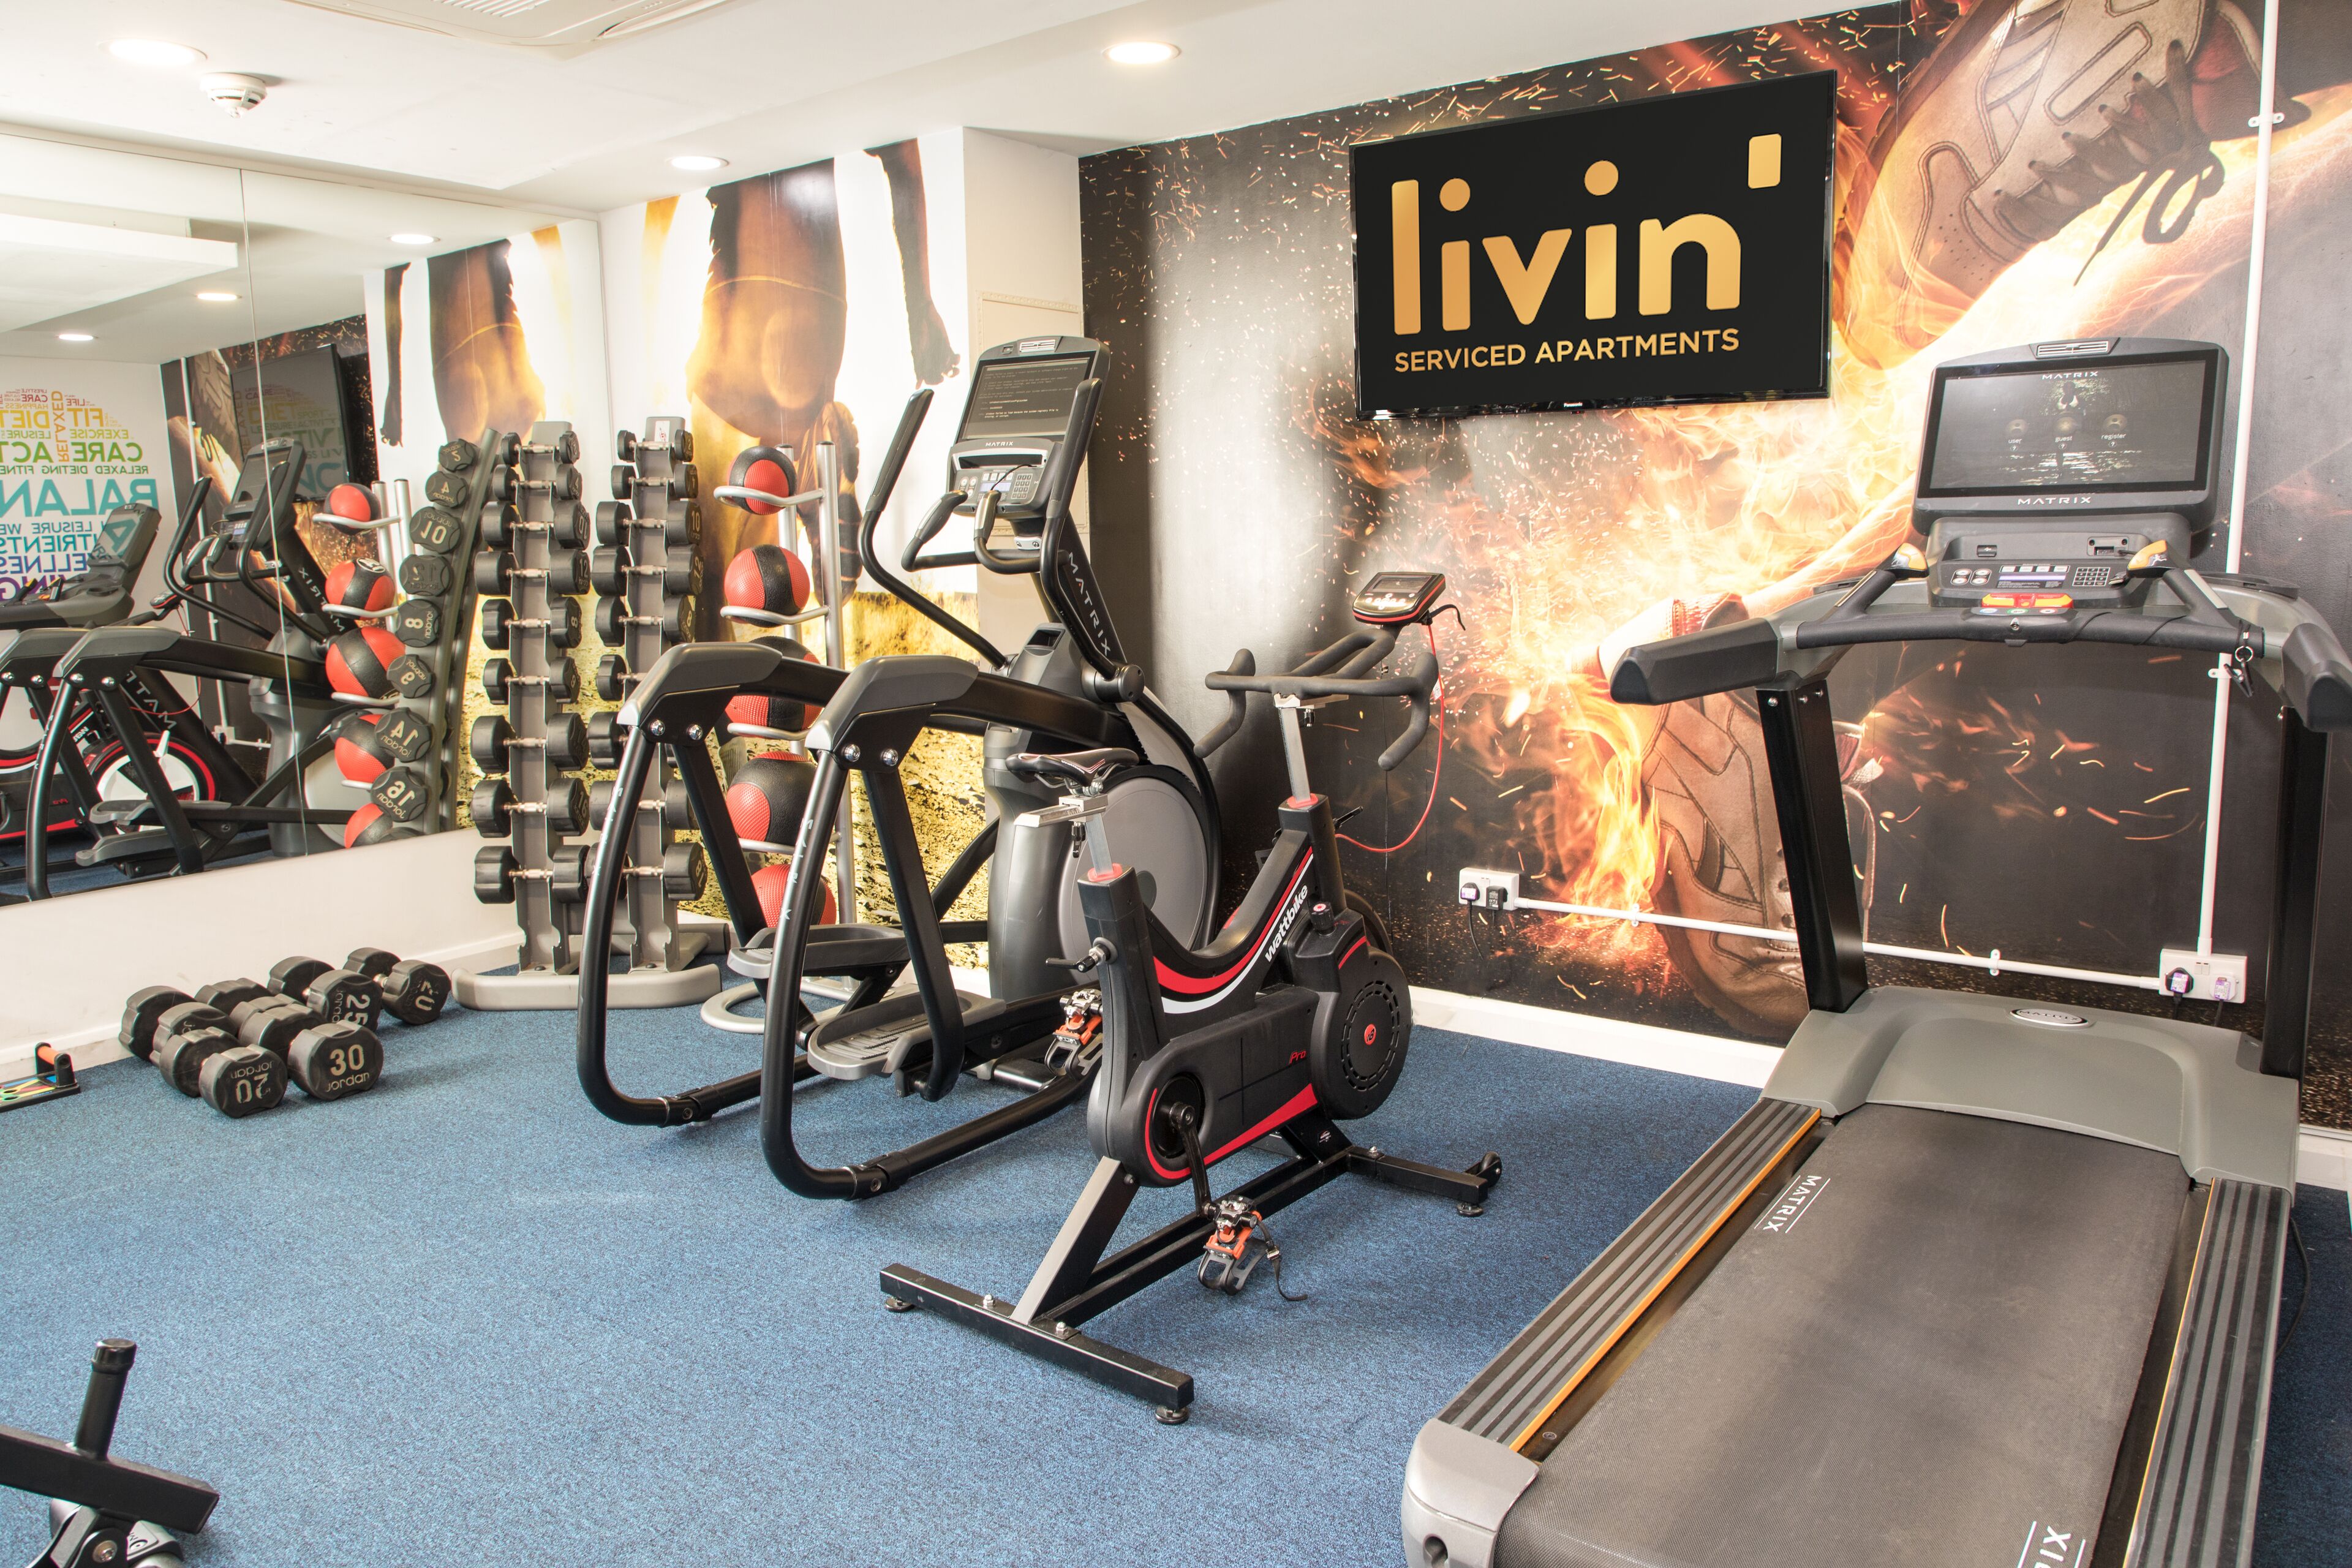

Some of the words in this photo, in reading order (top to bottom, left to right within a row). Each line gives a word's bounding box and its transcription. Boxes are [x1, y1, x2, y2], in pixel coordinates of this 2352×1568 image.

[1394, 342, 1527, 373] SERVICED
[1534, 327, 1740, 364] APARTMENTS
[2041, 371, 2099, 380] MATRIX
[2017, 496, 2092, 507] MATRIX
[692, 510, 701, 531] 10
[1068, 552, 1111, 655] MATRIX
[1264, 884, 1308, 963] wattbike
[329, 1044, 365, 1076] 30
[1288, 1049, 1307, 1065] Pro
[325, 1071, 371, 1093] jordan
[1762, 1175, 1822, 1232] MATRIX
